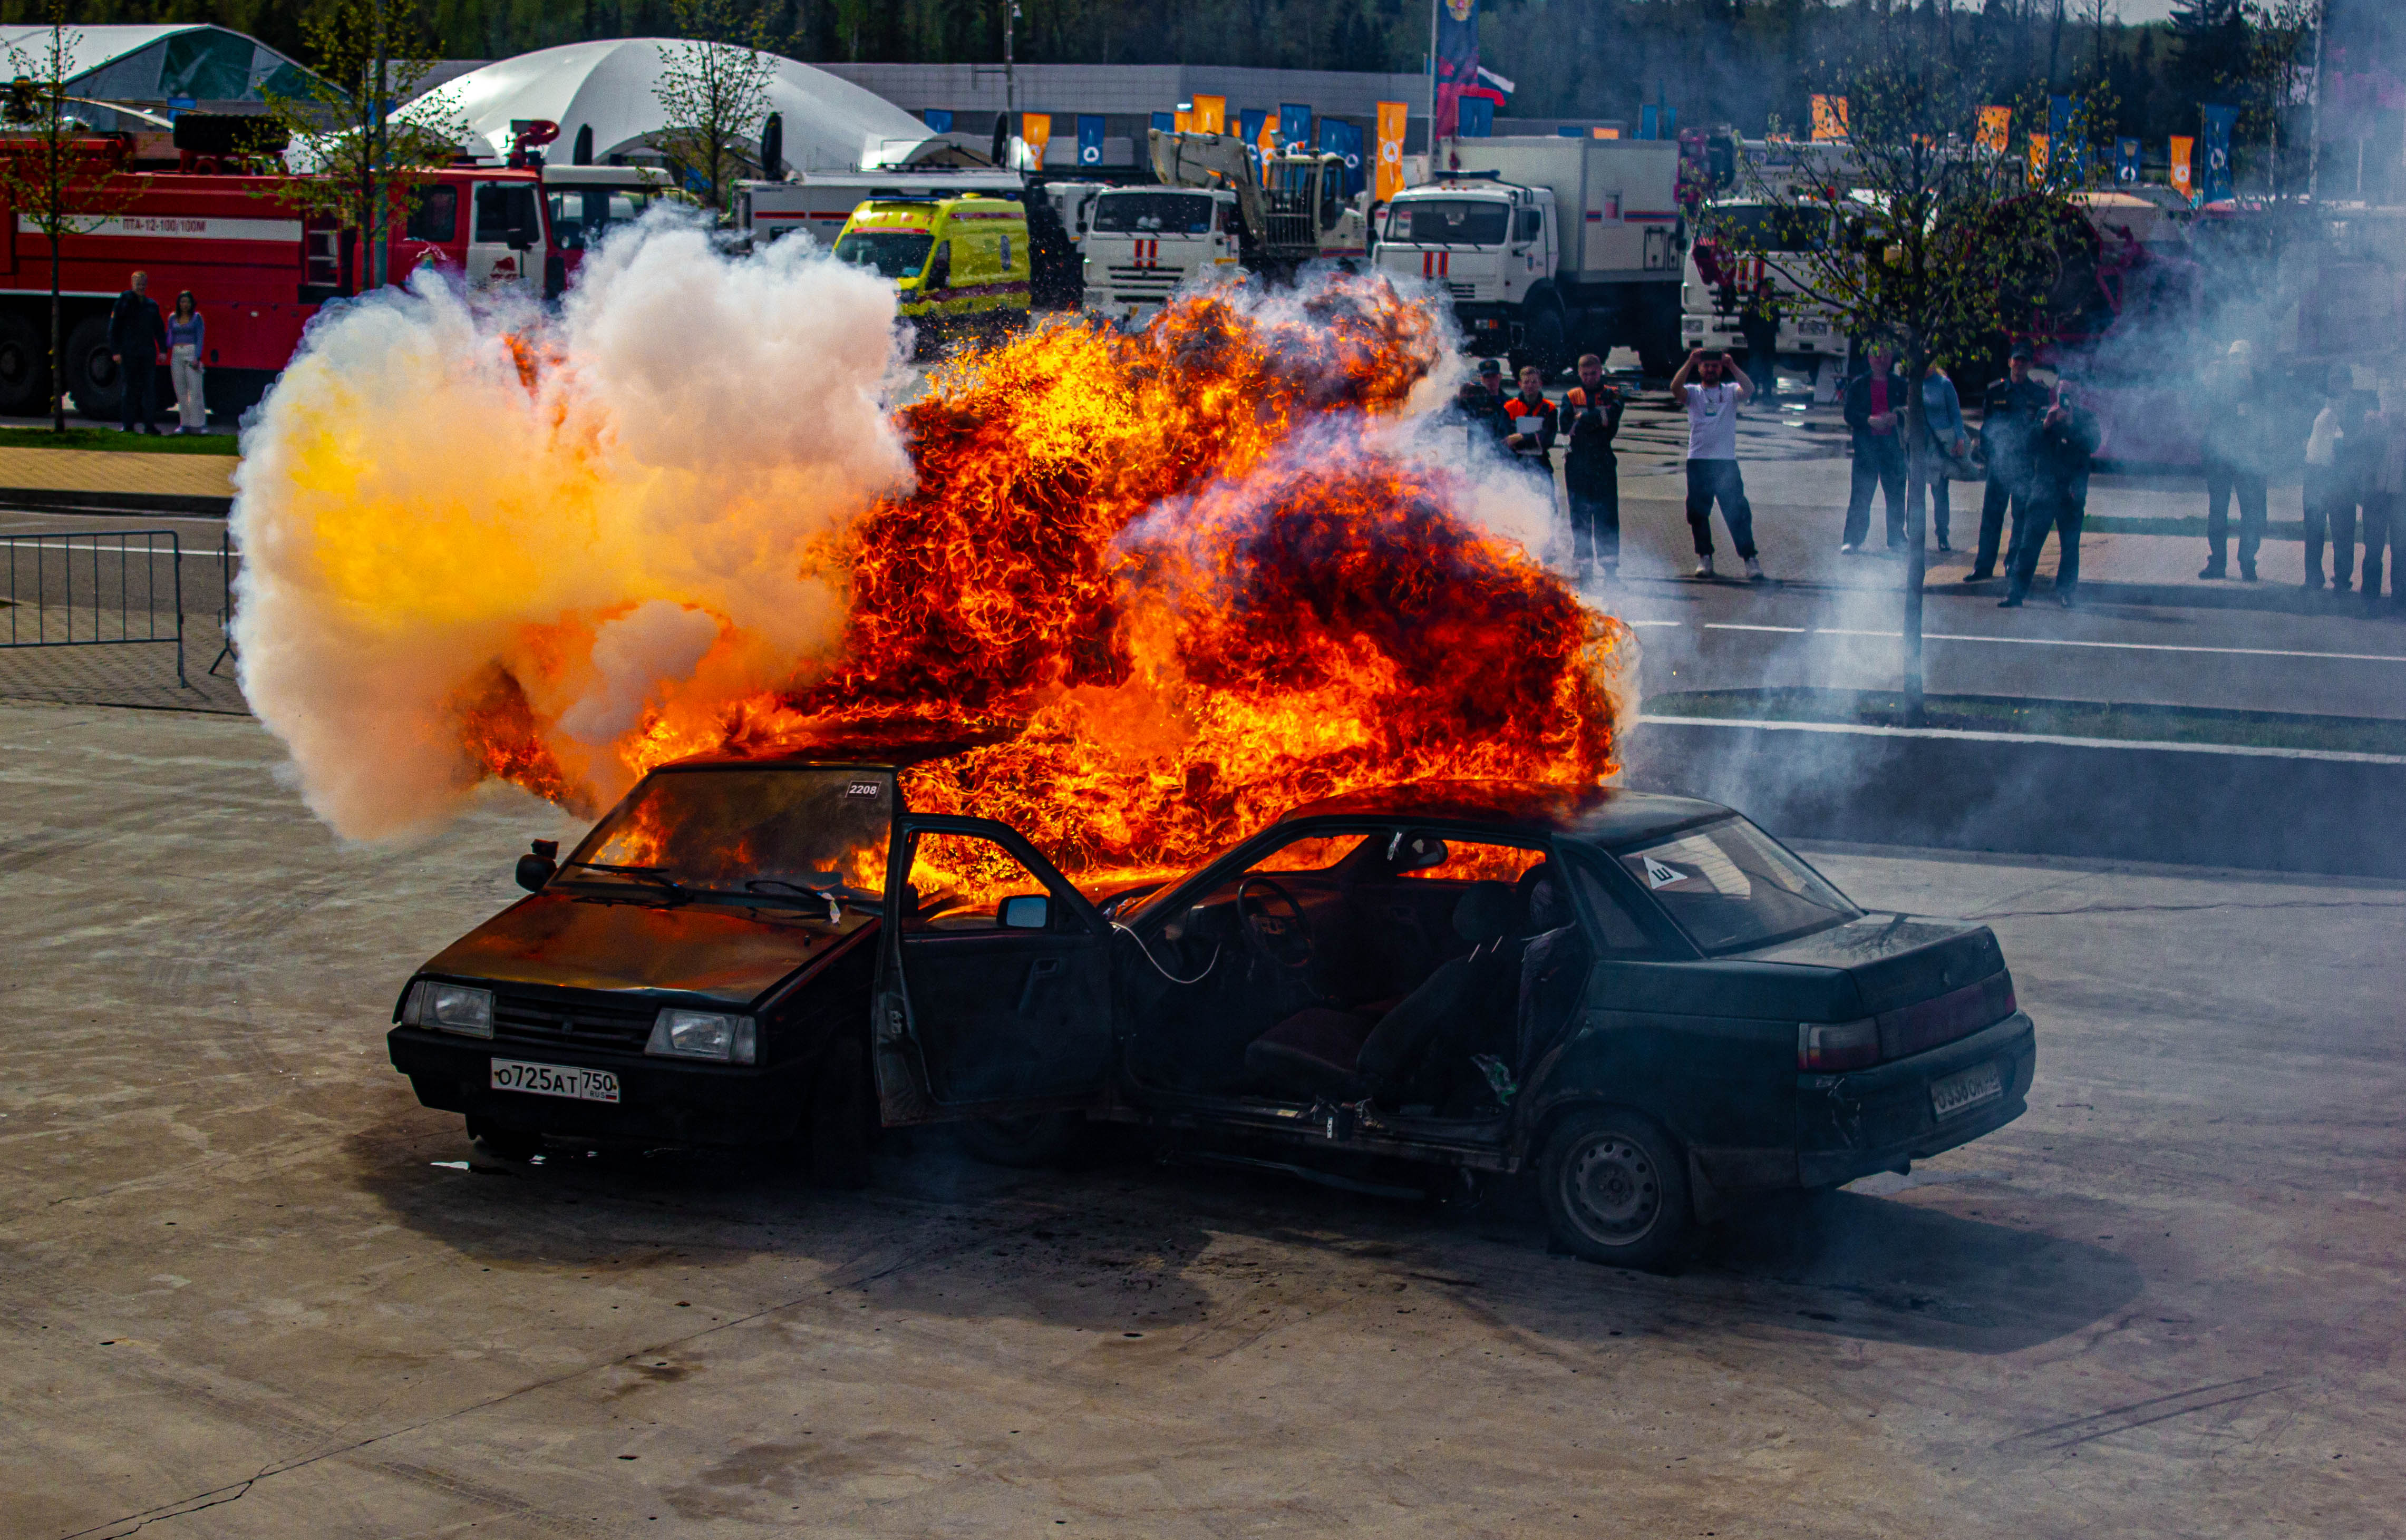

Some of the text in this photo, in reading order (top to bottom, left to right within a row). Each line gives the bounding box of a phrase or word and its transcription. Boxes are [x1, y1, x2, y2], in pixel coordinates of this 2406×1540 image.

[849, 785, 877, 795] 2208
[1651, 867, 1674, 881] Ш
[498, 1065, 613, 1094] О725АТ 750
[590, 1090, 606, 1099] RUS
